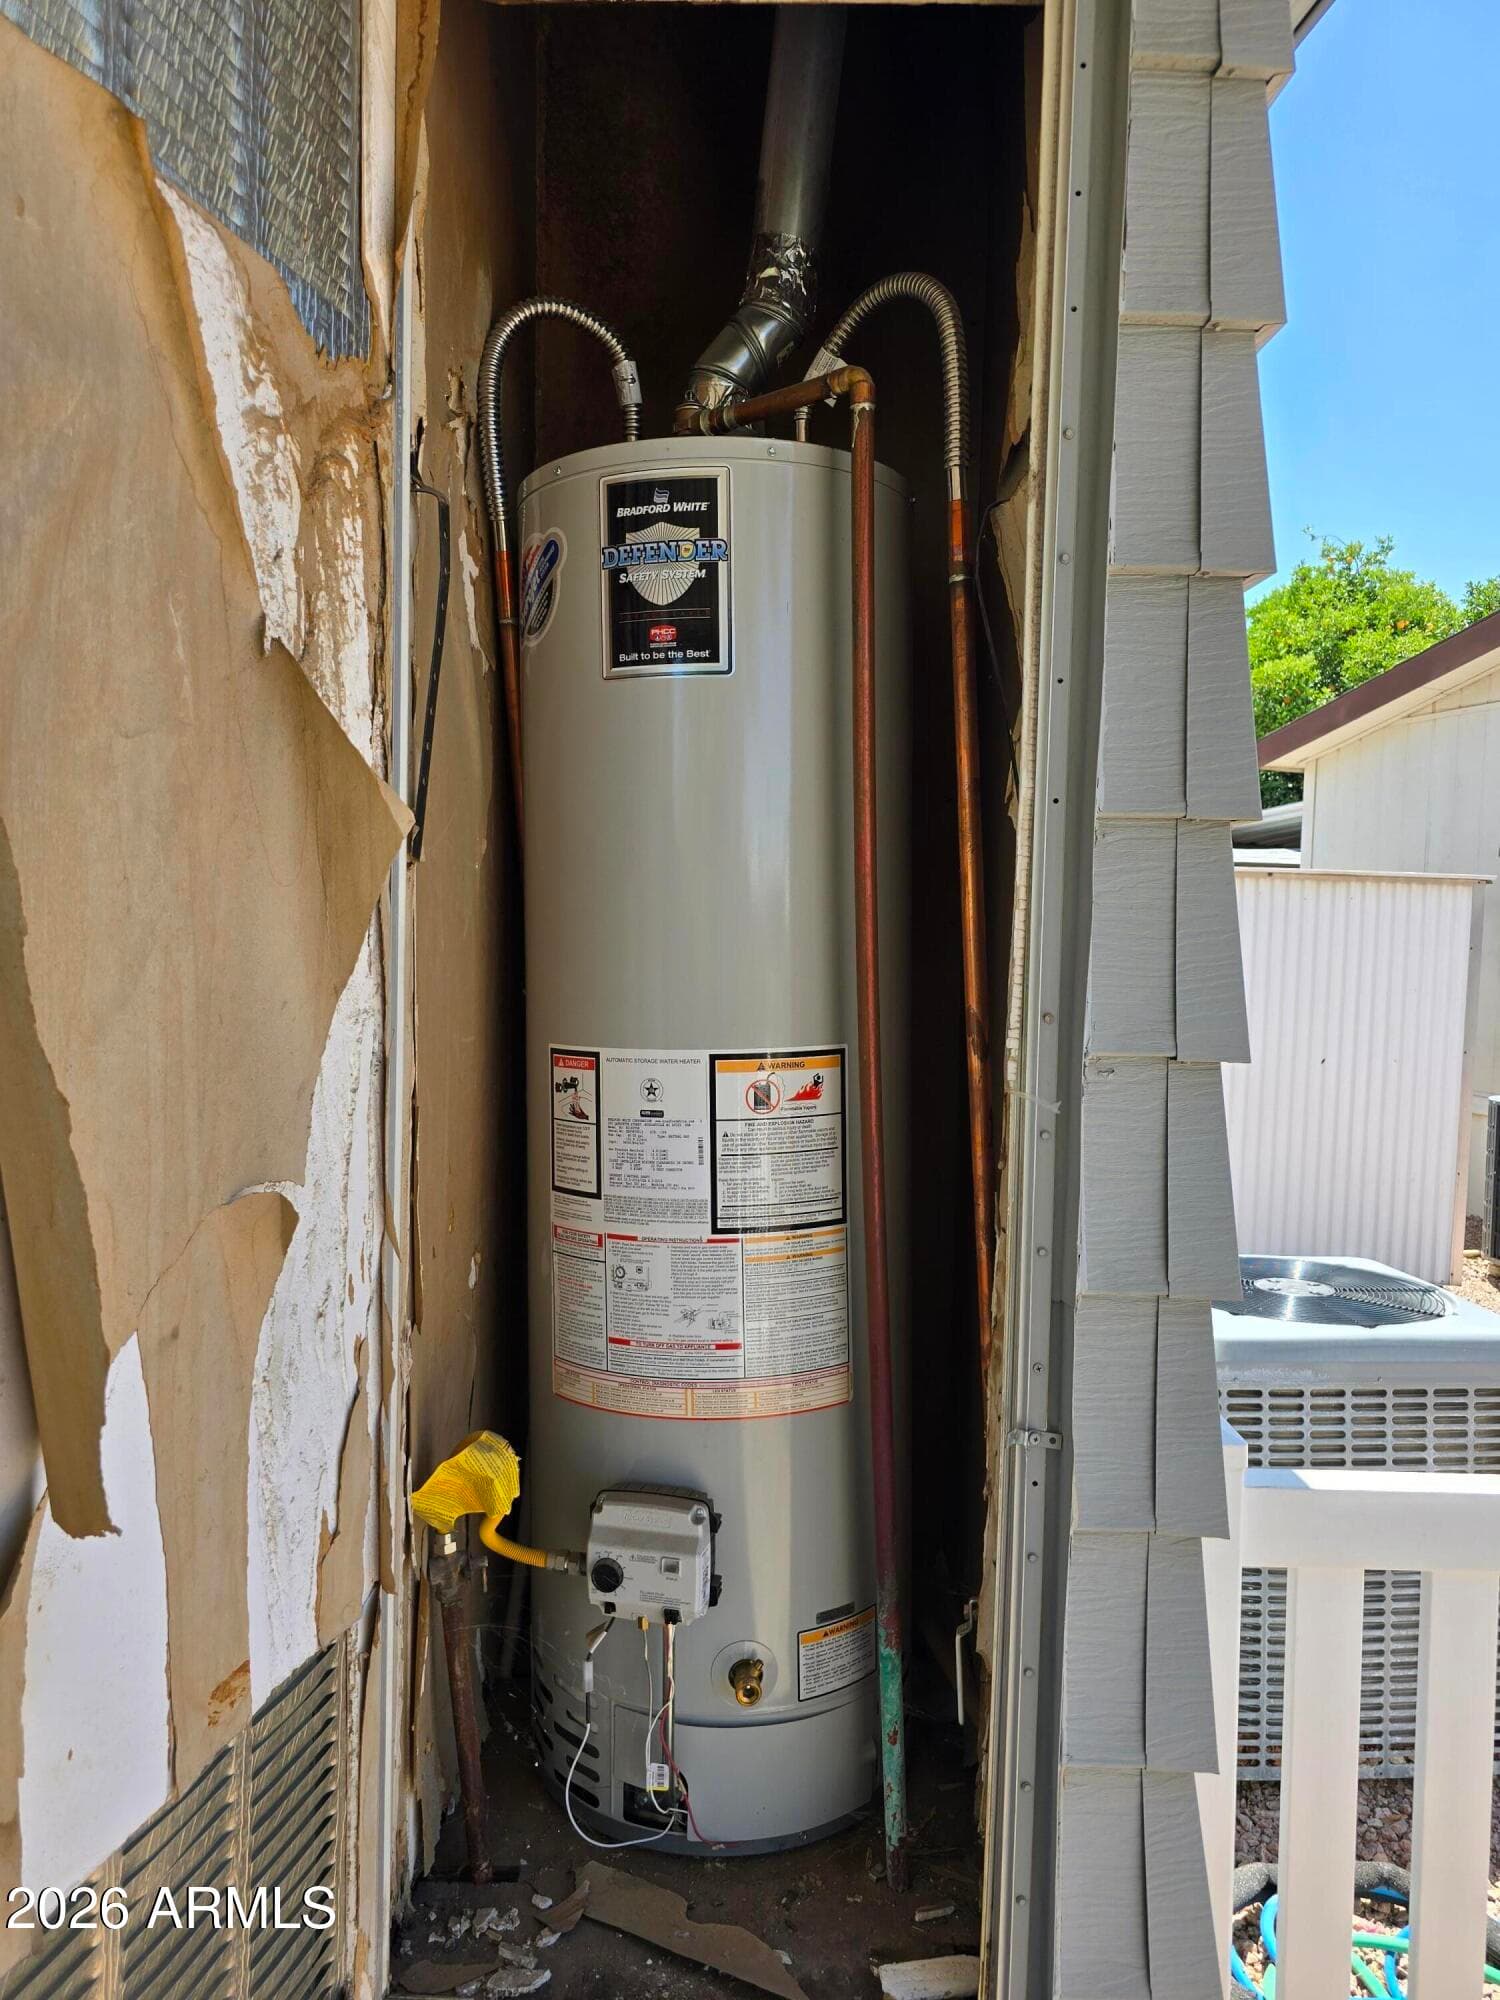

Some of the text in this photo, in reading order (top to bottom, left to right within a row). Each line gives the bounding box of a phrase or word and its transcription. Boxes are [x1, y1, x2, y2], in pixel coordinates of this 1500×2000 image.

[616, 502, 708, 518] BRADFORD WHITE
[602, 538, 729, 570] DEFENDER
[619, 569, 706, 584] SAFETY SYSTEM
[651, 628, 676, 636] PHCC
[619, 650, 710, 662] Built to be the Best
[565, 1059, 590, 1068] DANGER
[768, 1061, 806, 1069] WARNING
